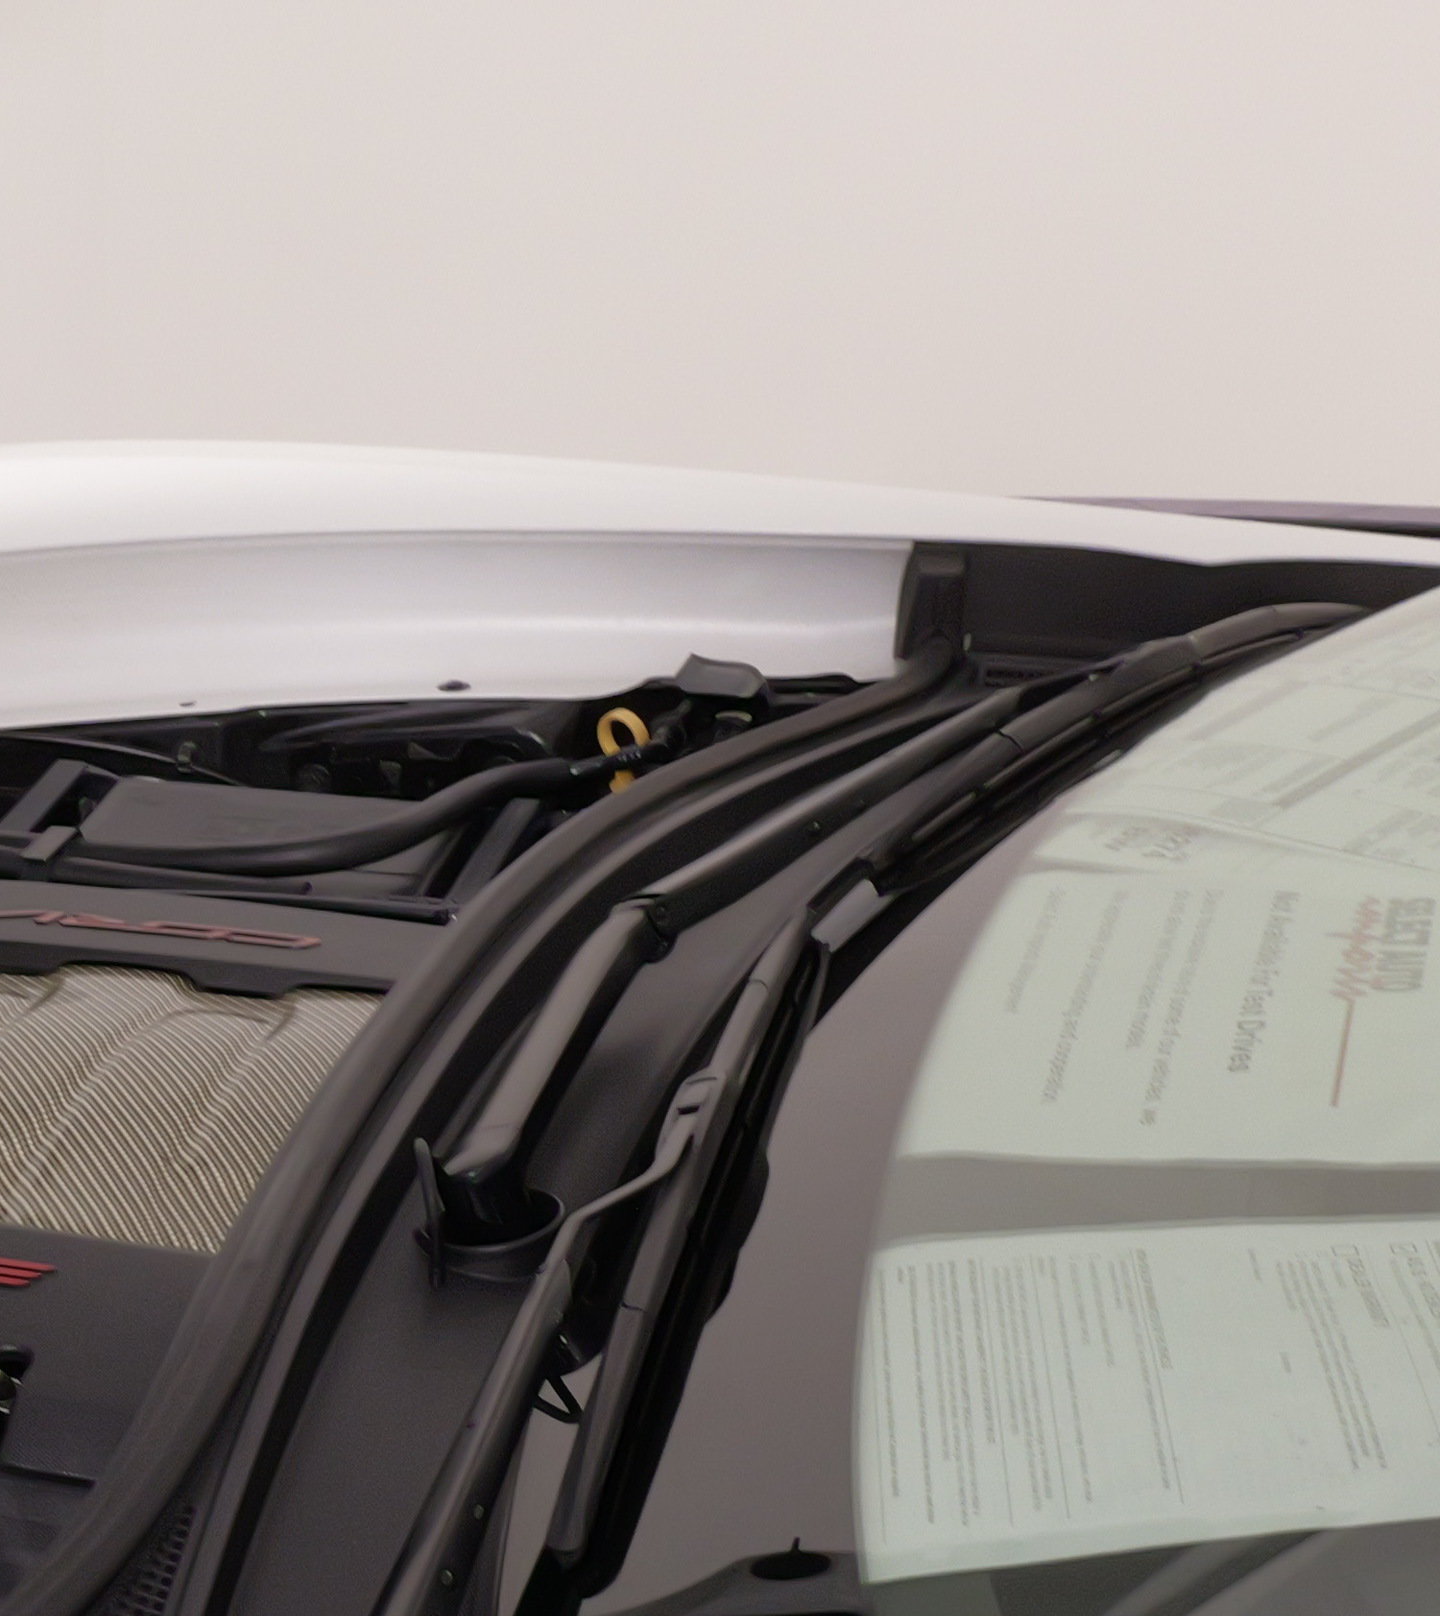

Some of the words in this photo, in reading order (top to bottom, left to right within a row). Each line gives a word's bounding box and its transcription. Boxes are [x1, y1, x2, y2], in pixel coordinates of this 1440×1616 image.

[1382, 898, 1437, 945] SELECT
[1370, 951, 1427, 992] AUTO
[1239, 987, 1275, 1017] Test
[1224, 1018, 1267, 1074] Drives
